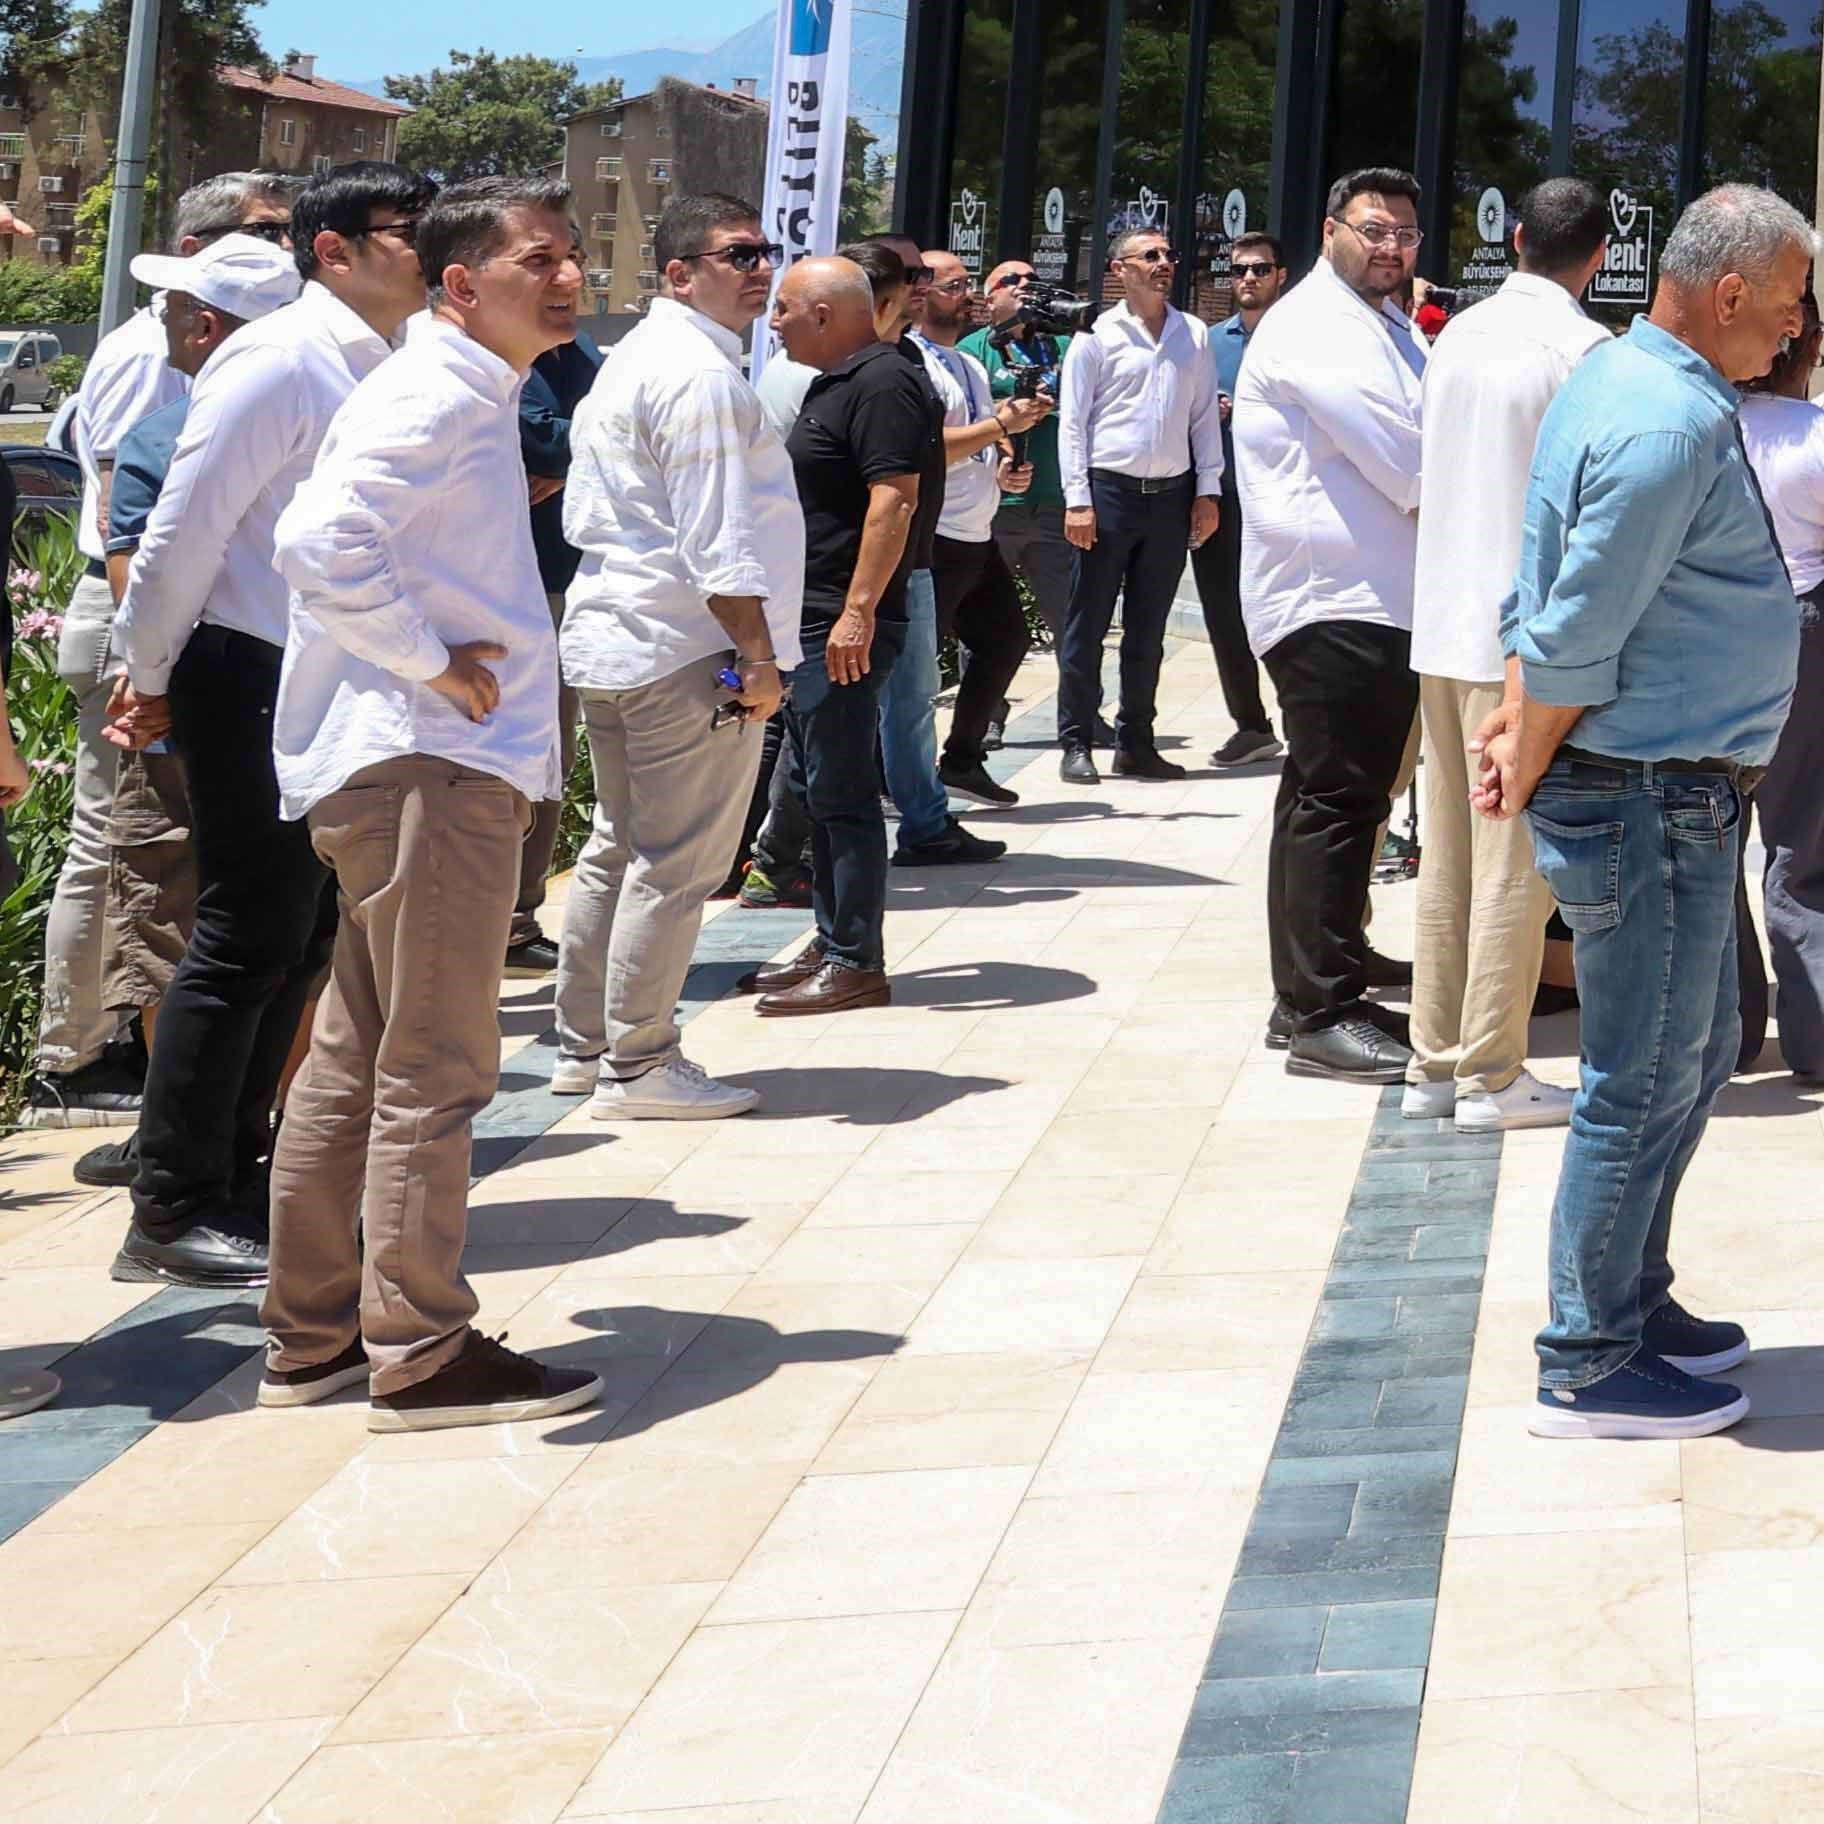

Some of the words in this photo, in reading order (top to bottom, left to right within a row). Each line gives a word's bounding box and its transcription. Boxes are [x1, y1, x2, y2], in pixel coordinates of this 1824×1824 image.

[952, 222, 981, 251] Kent
[1472, 247, 1506, 260] ANTALYA
[1595, 272, 1644, 292] Lokantası
